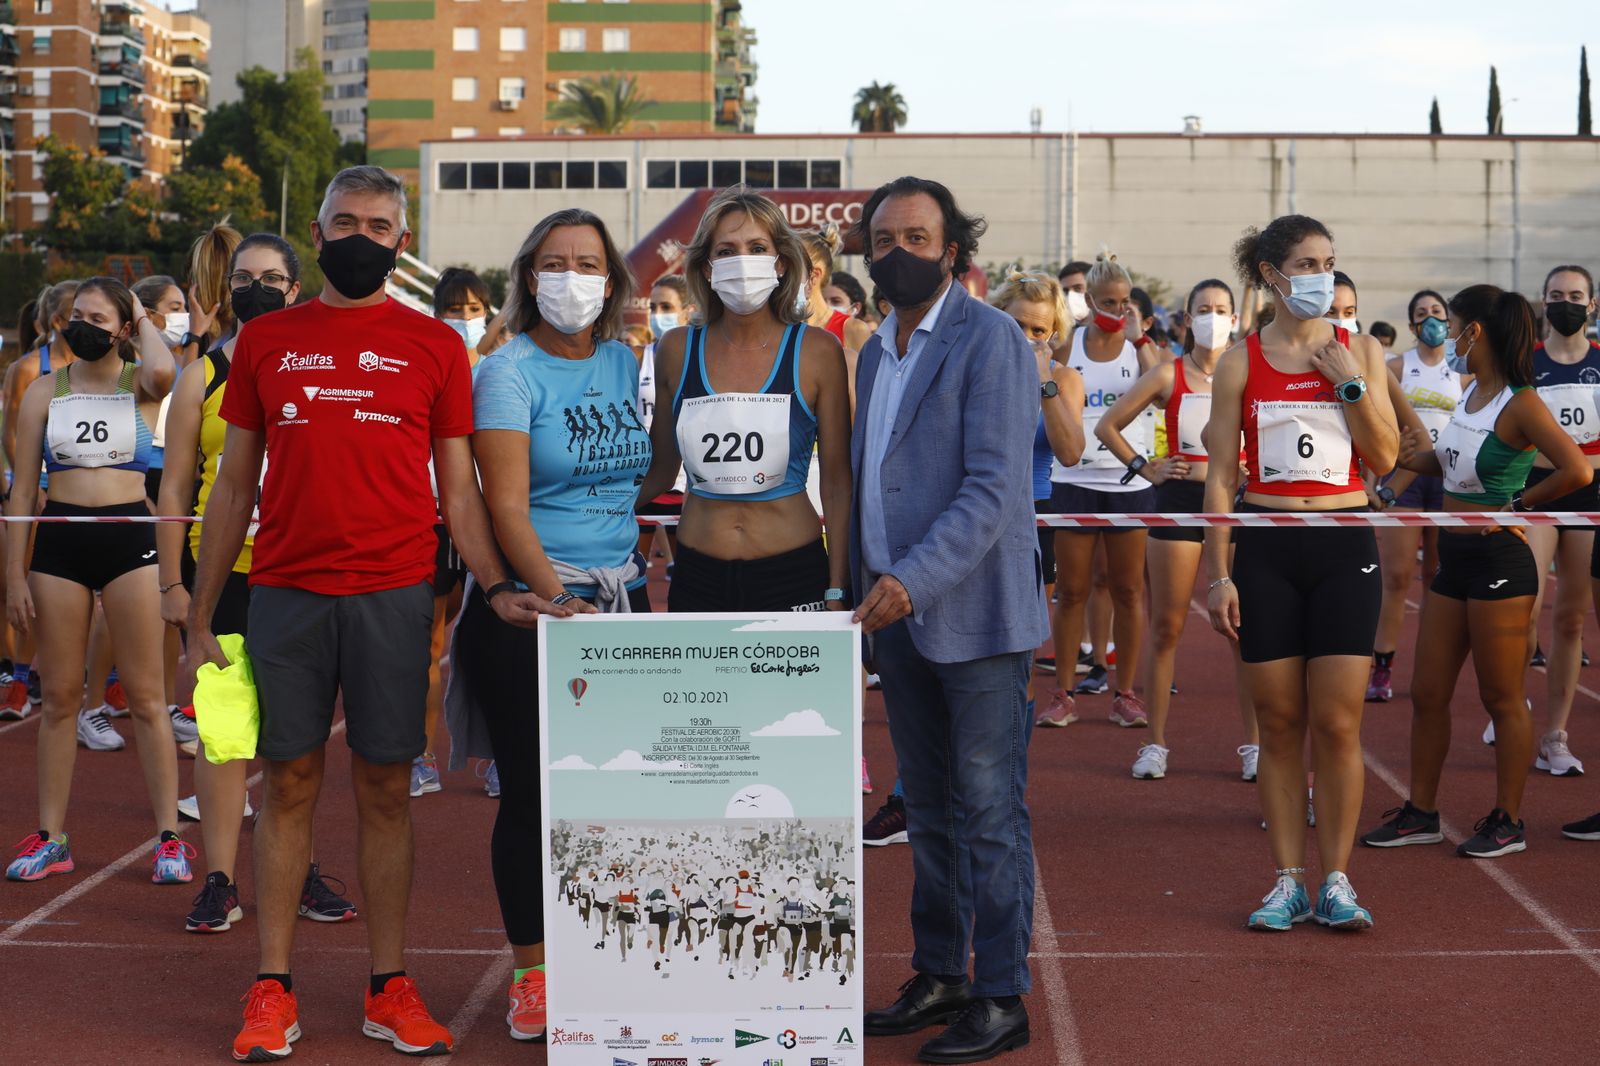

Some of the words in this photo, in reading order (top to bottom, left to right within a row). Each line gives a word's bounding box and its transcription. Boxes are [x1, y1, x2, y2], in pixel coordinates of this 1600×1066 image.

[291, 353, 333, 366] califas
[319, 388, 374, 398] AGRIMENSUR
[353, 408, 402, 425] hymcor
[1560, 407, 1585, 426] 50
[76, 420, 108, 444] 26
[702, 432, 764, 463] 220
[1297, 433, 1314, 459] 6
[572, 461, 610, 478] MUJER
[581, 647, 608, 660] XVI
[612, 647, 682, 660] CARRERA
[686, 646, 738, 659] MUJER
[742, 642, 820, 659] CÓRDOBA
[715, 666, 748, 674] PREMIO
[663, 691, 728, 704] 02.10.2021
[562, 1032, 594, 1042] califas
